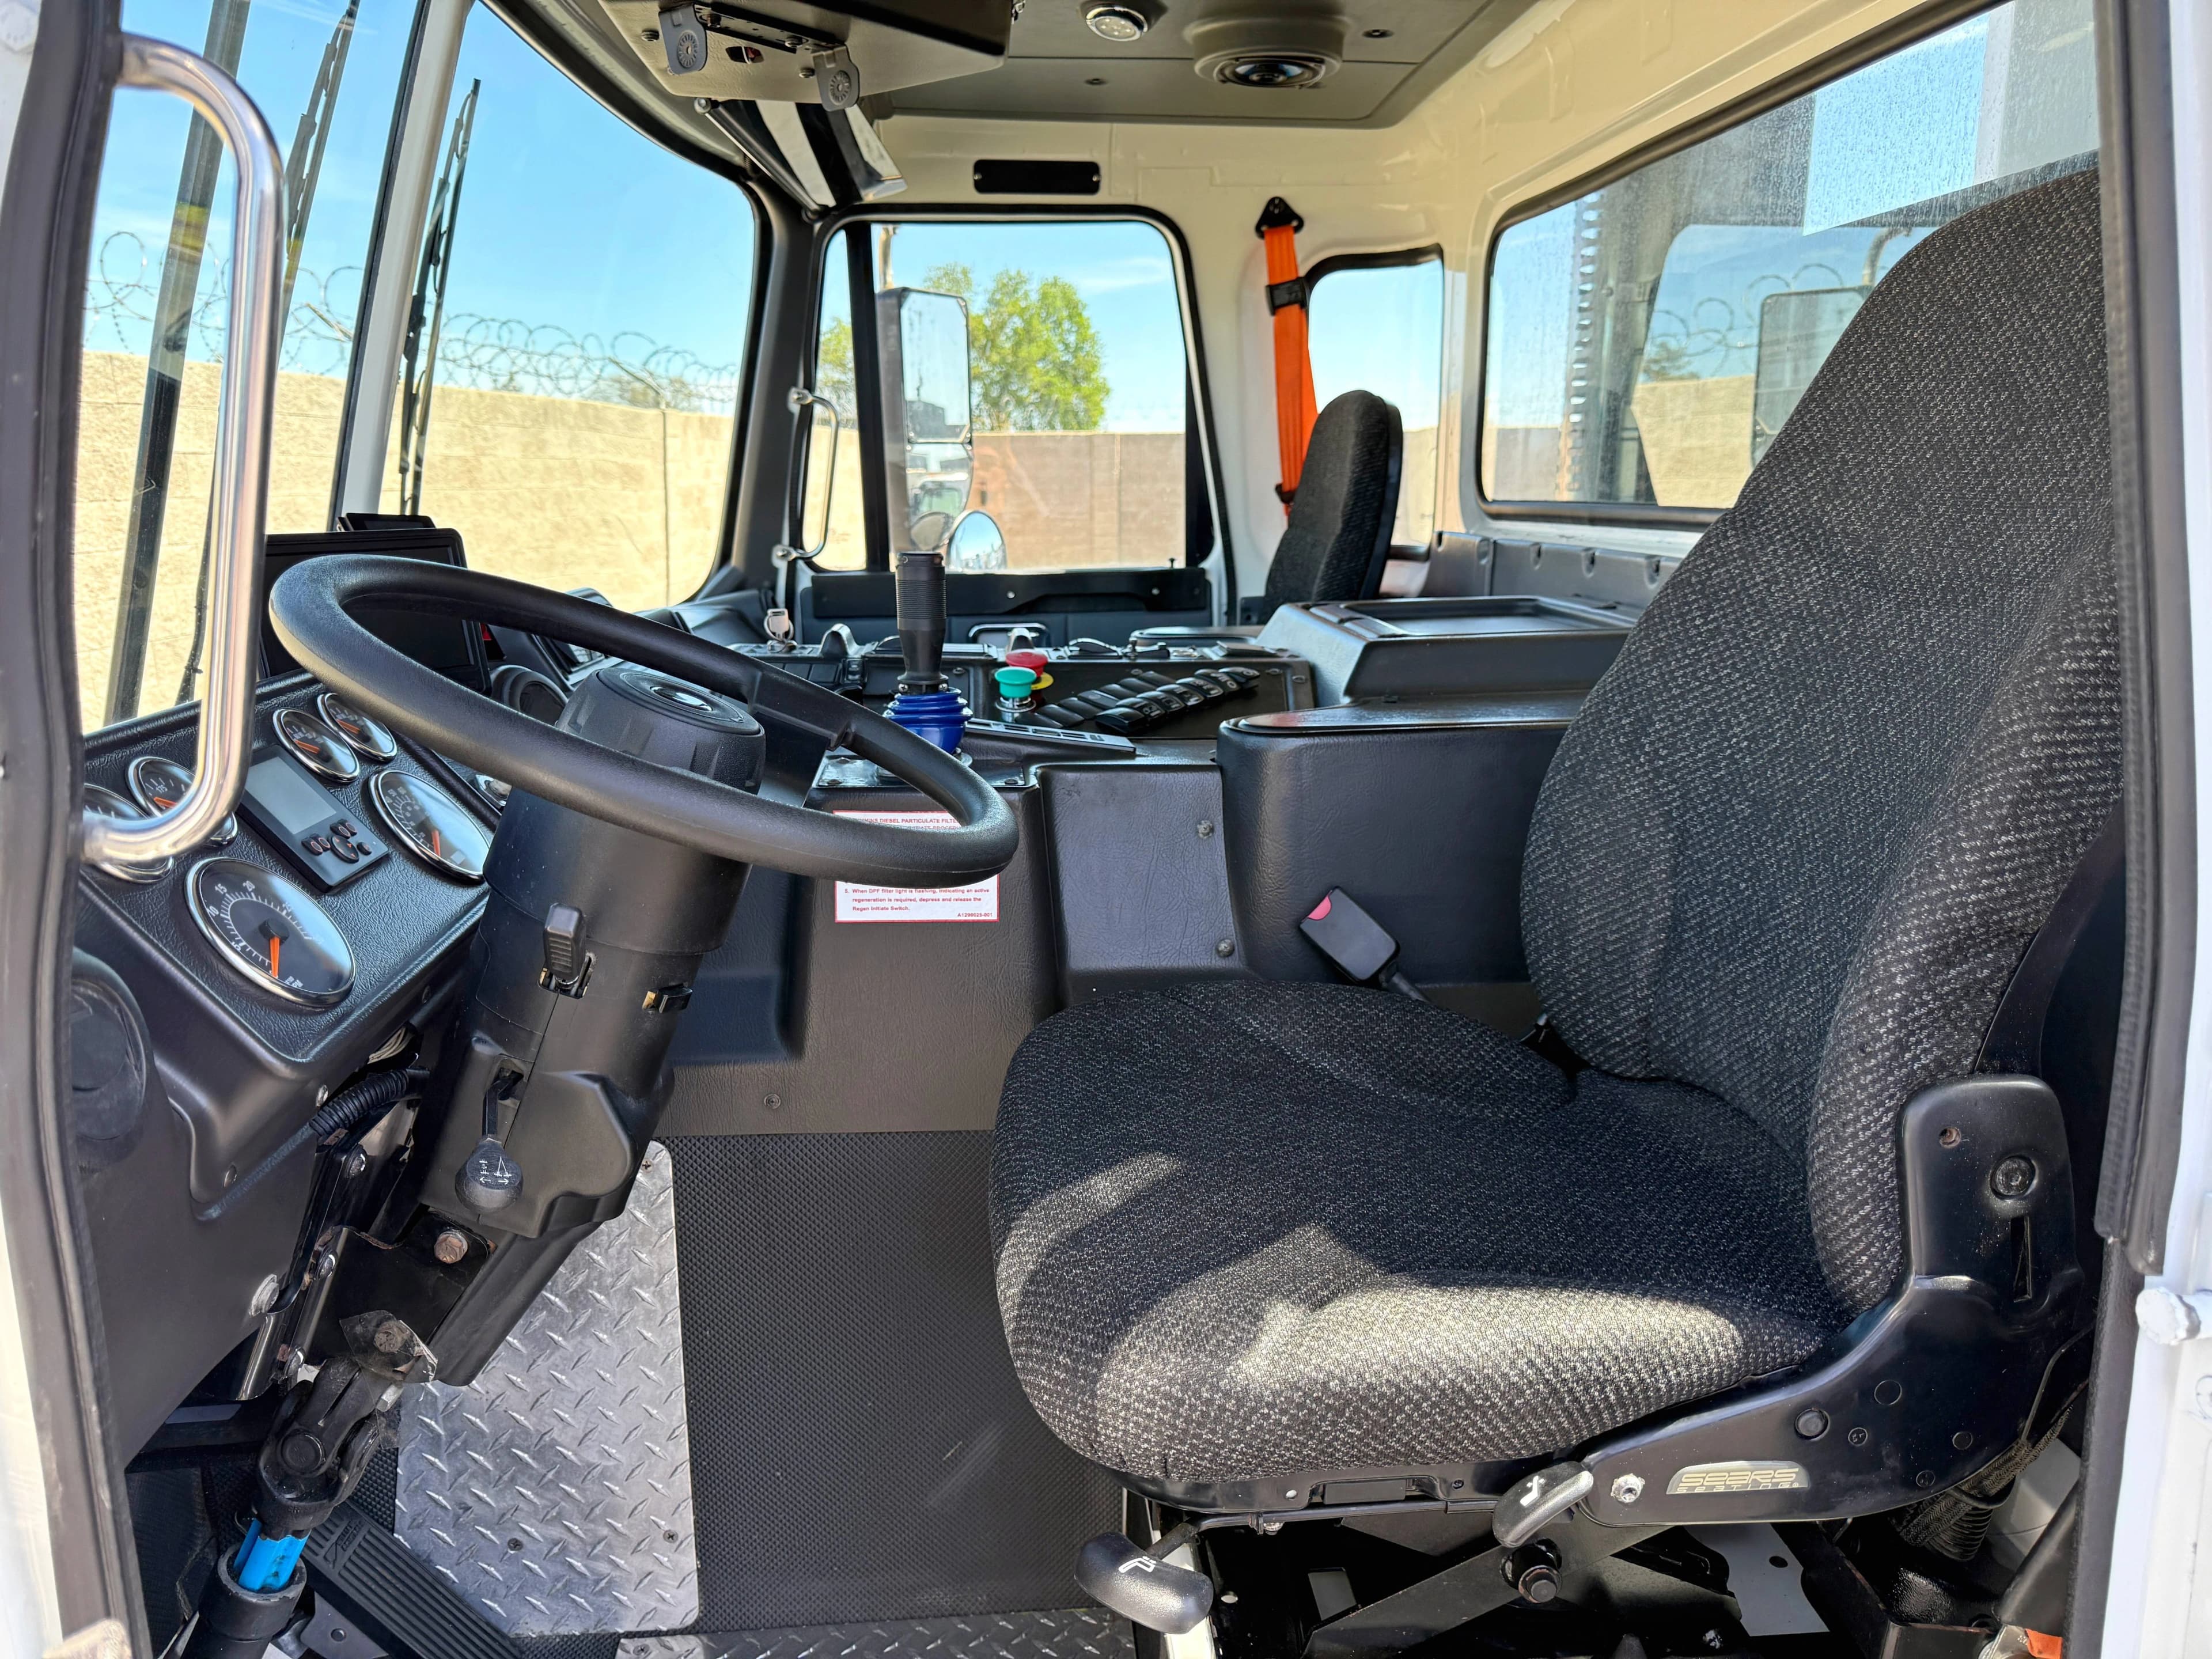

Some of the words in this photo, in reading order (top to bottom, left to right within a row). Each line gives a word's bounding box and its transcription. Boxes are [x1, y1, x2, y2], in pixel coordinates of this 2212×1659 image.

[214, 883, 227, 894] 15
[243, 880, 255, 892] 20
[1679, 1468, 1799, 1487] SEARS
